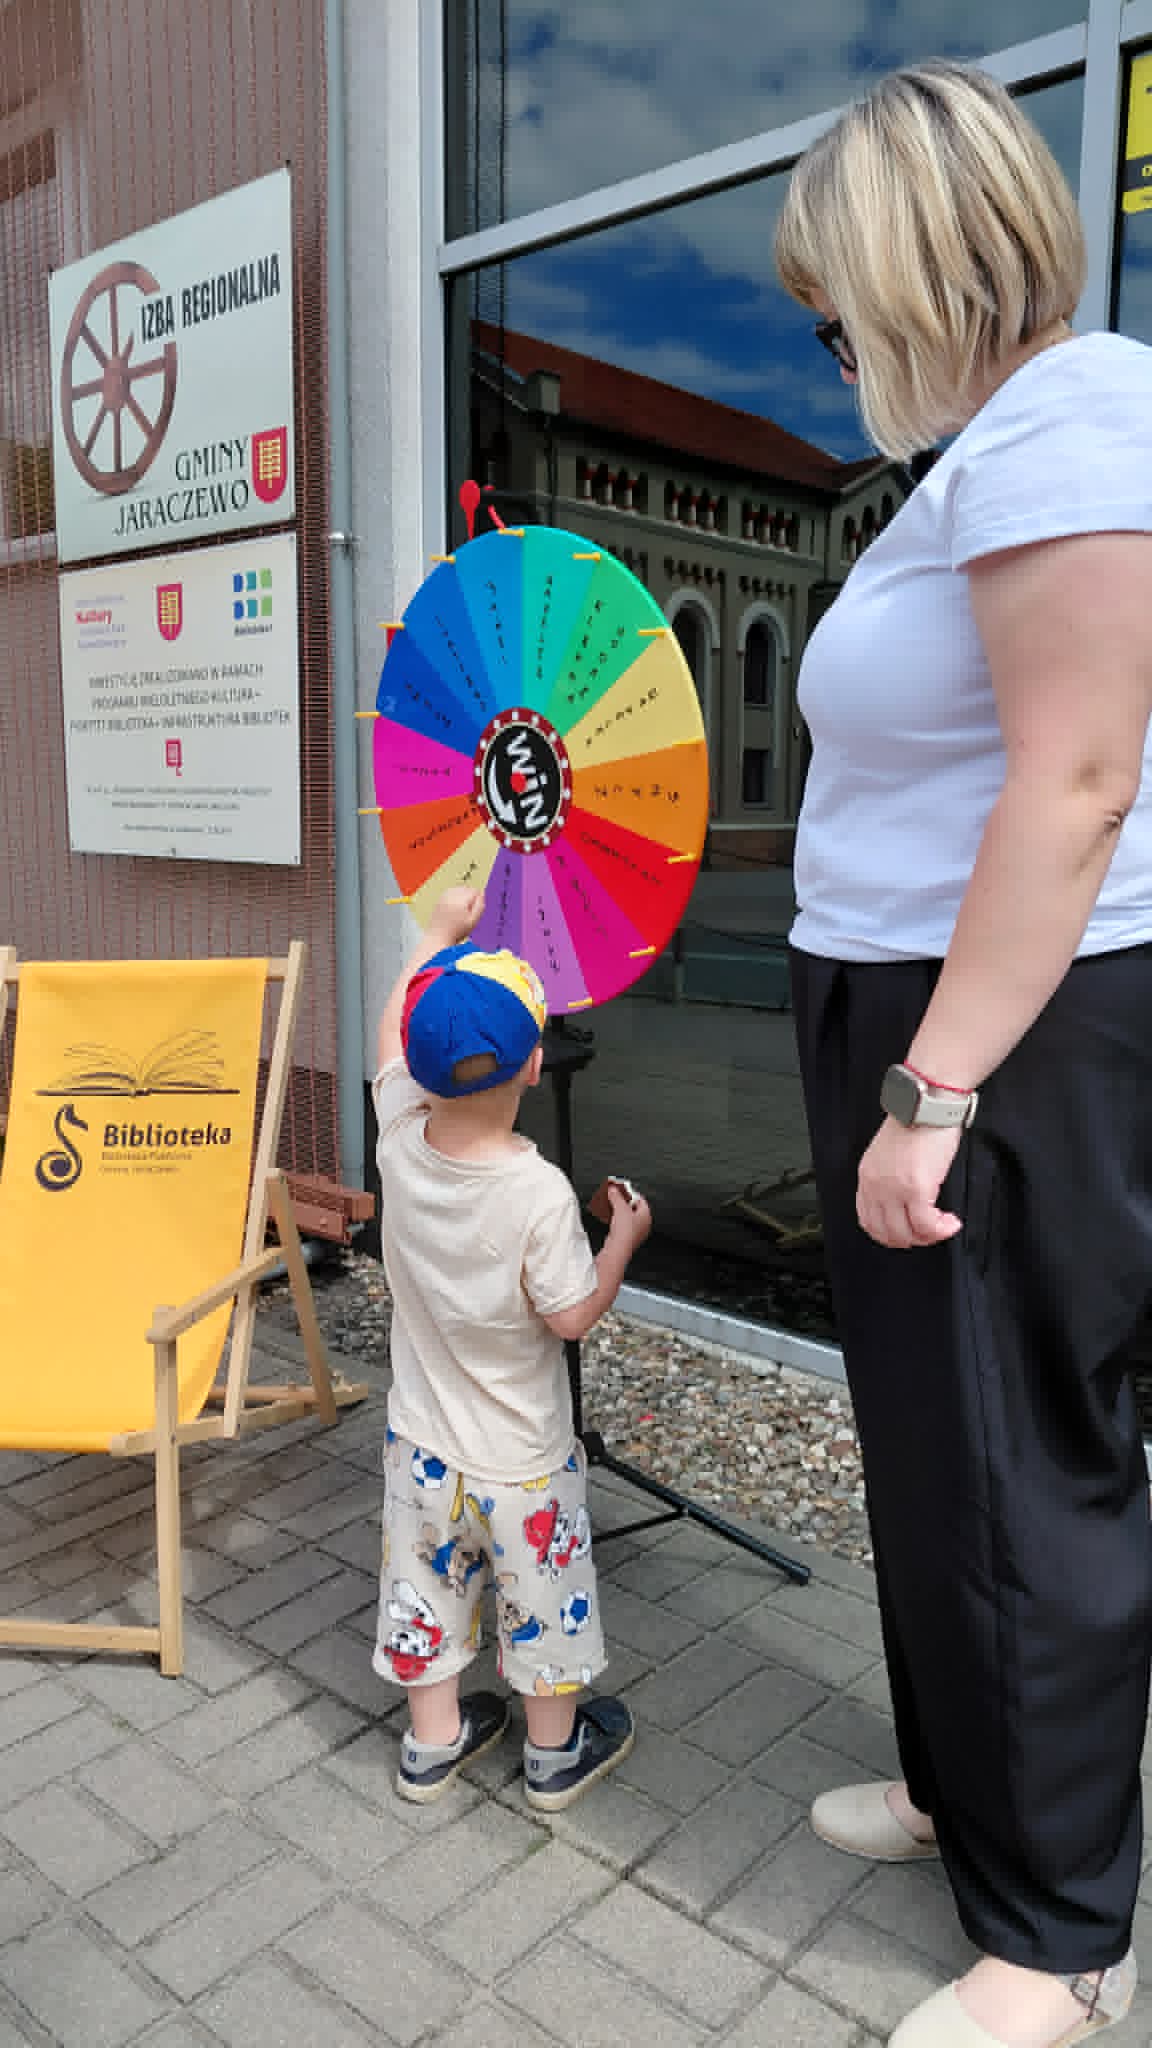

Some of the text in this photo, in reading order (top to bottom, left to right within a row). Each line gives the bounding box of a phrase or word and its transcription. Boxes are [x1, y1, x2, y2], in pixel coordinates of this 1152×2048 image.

[141, 252, 281, 344] IZBA REGIONALNA
[175, 436, 248, 481] GMINY
[113, 479, 249, 537] JARACZEWO
[221, 663, 264, 680] RAMACH
[102, 1121, 233, 1148] Biblioteka
